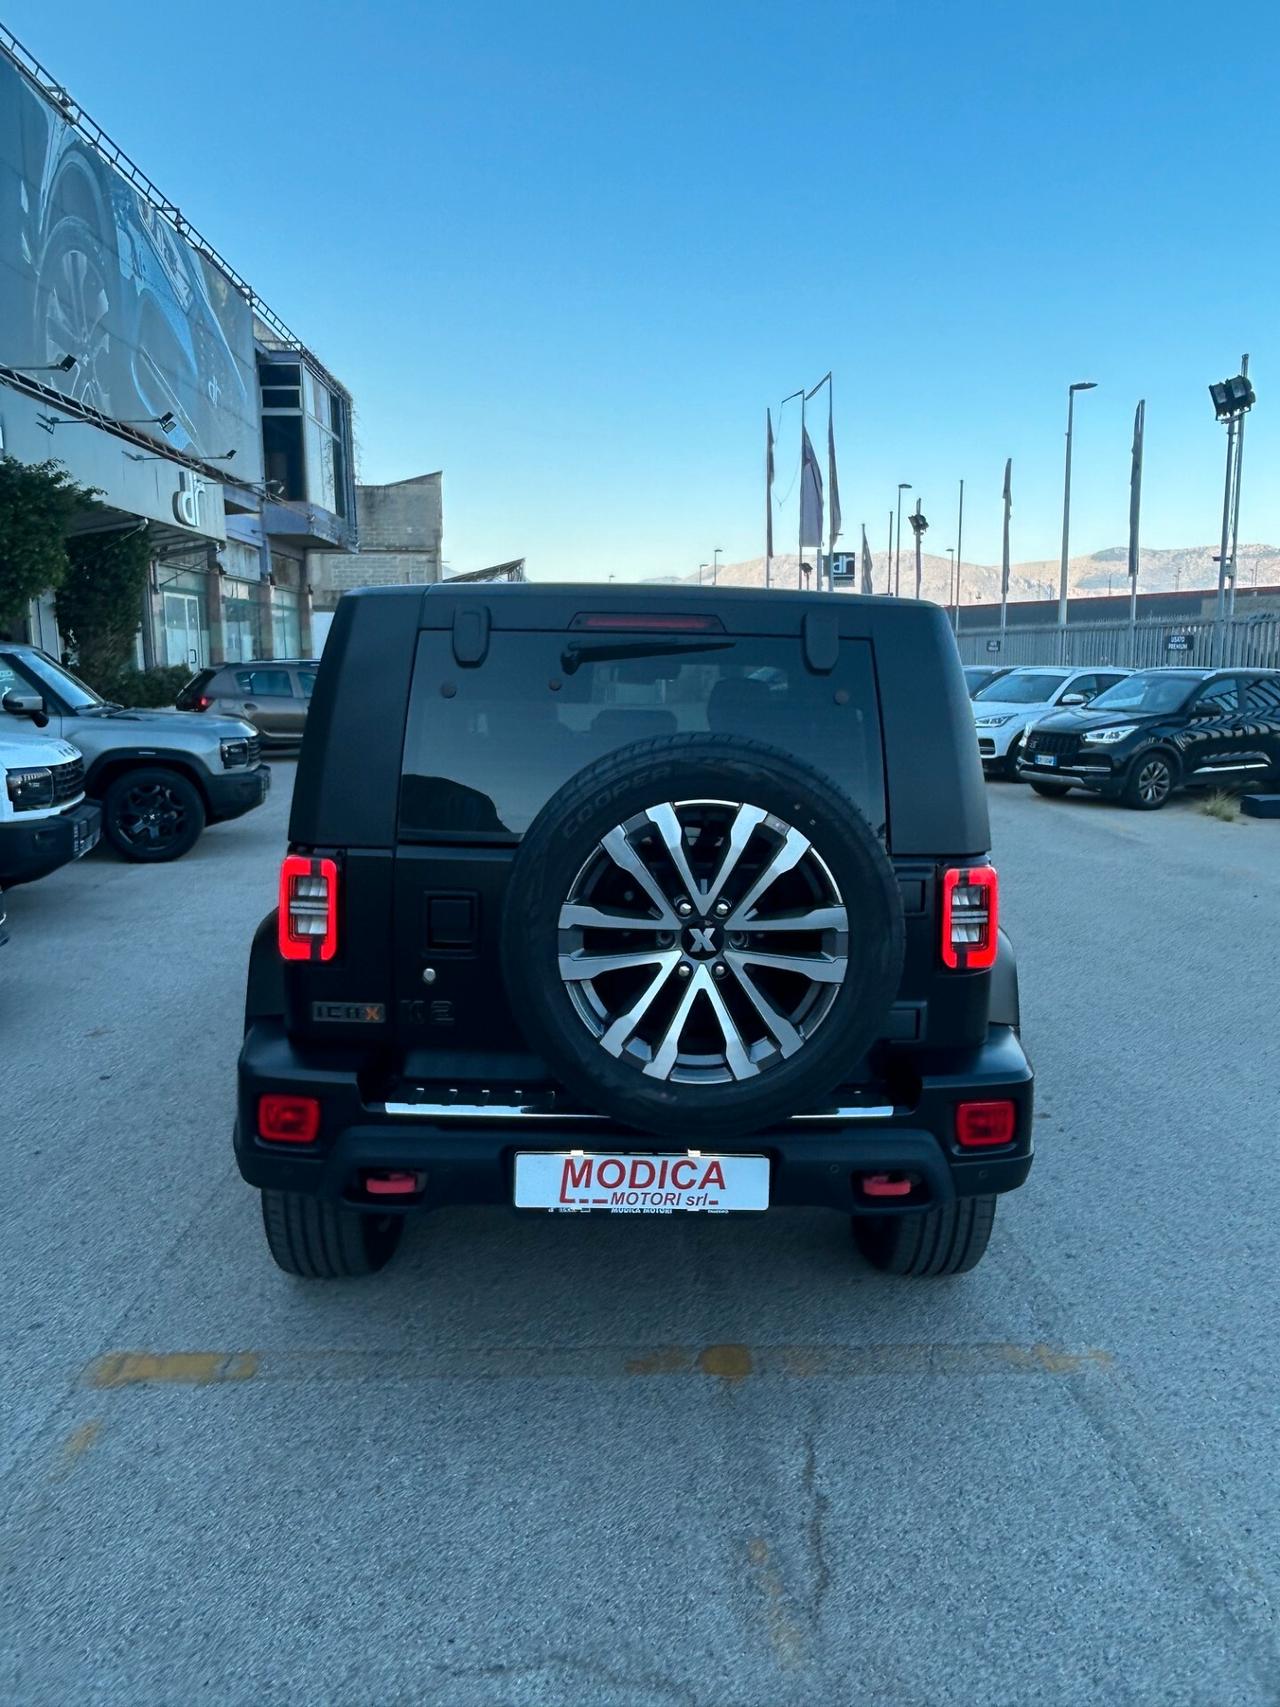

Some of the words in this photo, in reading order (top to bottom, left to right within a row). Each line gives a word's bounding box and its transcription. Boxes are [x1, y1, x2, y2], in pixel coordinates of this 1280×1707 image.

[172, 471, 205, 527] dr
[832, 555, 854, 573] dr
[560, 1158, 726, 1192] MODICA
[611, 1192, 681, 1206] MOTORI
[686, 1193, 708, 1206] srl
